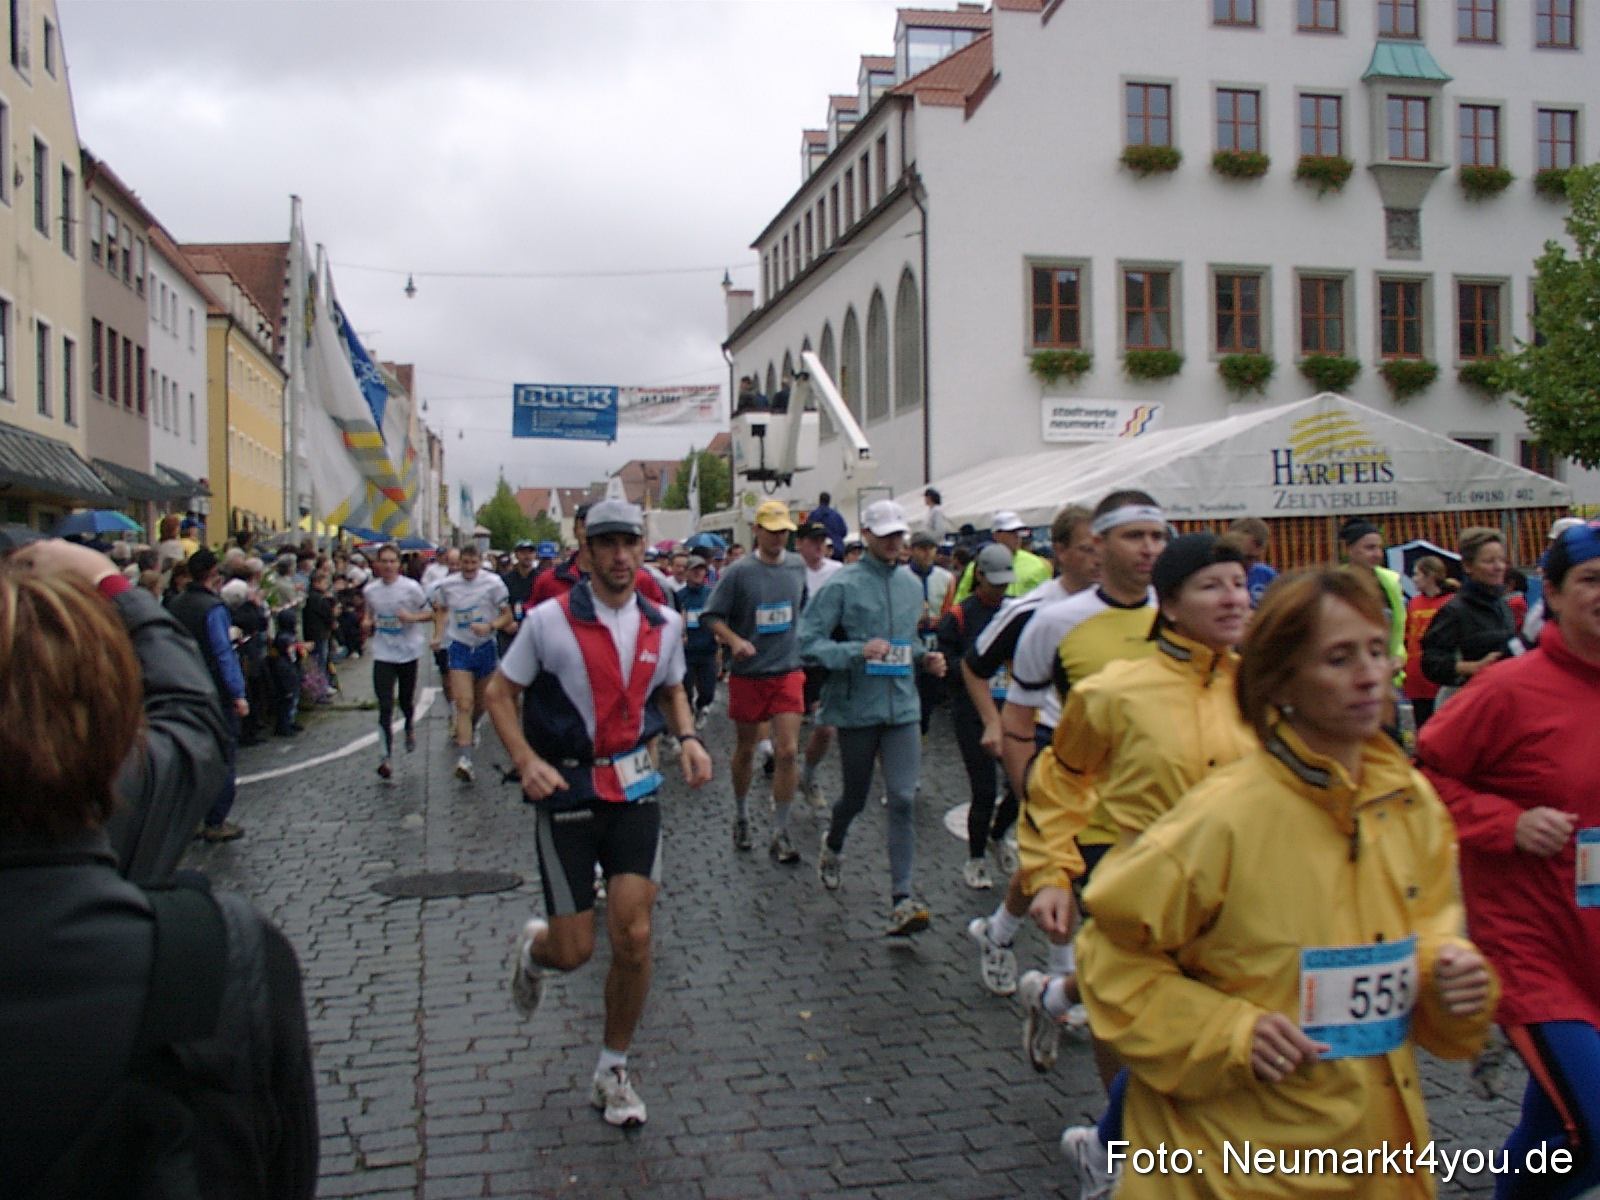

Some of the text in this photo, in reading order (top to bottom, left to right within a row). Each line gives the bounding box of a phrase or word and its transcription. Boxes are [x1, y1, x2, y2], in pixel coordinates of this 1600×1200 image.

[1052, 407, 1117, 418] stadtwerke
[1050, 420, 1106, 430] neumarkt
[1273, 489, 1398, 510] ZELTVERLEIH
